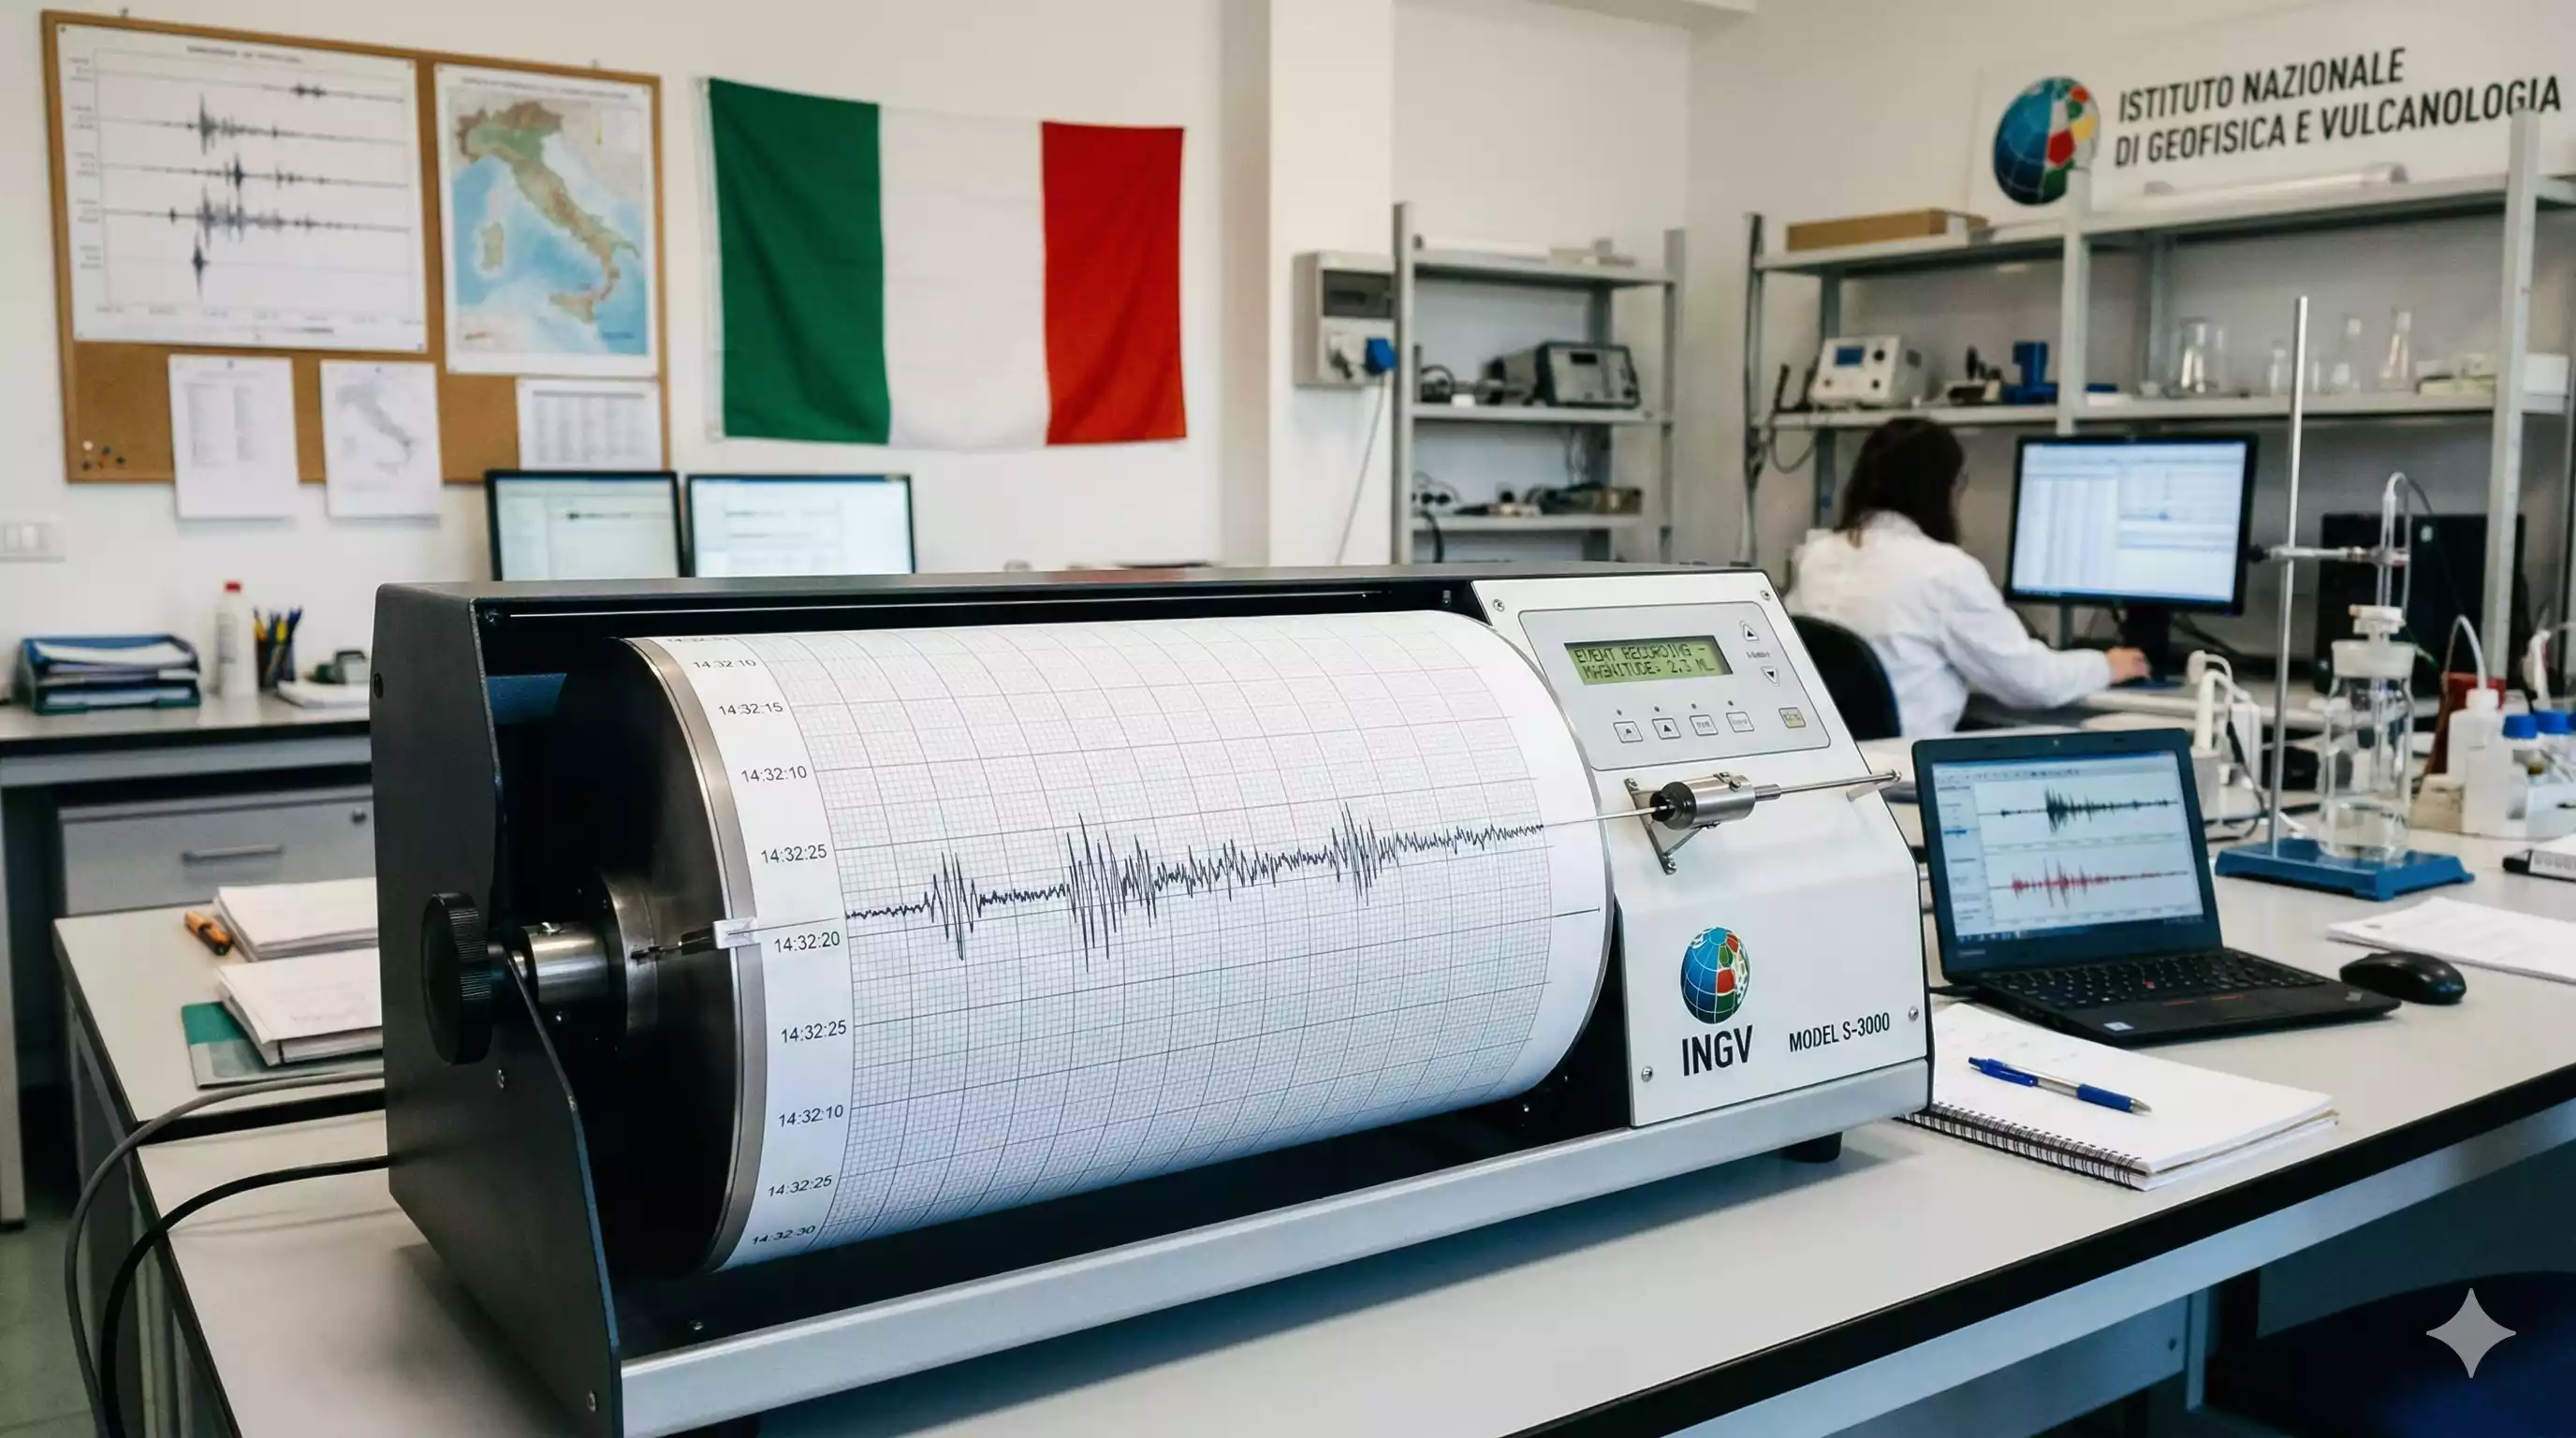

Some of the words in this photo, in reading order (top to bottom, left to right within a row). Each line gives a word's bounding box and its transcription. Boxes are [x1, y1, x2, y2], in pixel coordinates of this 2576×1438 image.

[2118, 75, 2235, 124] ISTITUTO
[2242, 47, 2406, 106] NAZIONALE
[2115, 134, 2140, 169] DI
[2146, 113, 2286, 164] GEOFISICA
[2295, 109, 2313, 145] E
[2321, 74, 2562, 141] VULCANOLOGIA
[718, 701, 784, 716] 14:32:15
[740, 764, 808, 784] 14:32:10
[760, 843, 827, 864] 14:32:25
[773, 930, 841, 953] 14:32:20
[781, 1019, 847, 1044] 14:32:25
[1789, 1023, 1839, 1053] MODEL
[1842, 1012, 1891, 1041] S-3000
[1681, 1024, 1753, 1077] INGV
[778, 1103, 844, 1128] 14:32:10
[767, 1174, 833, 1197] 14:32:25
[752, 1225, 817, 1245] 14:32:30
